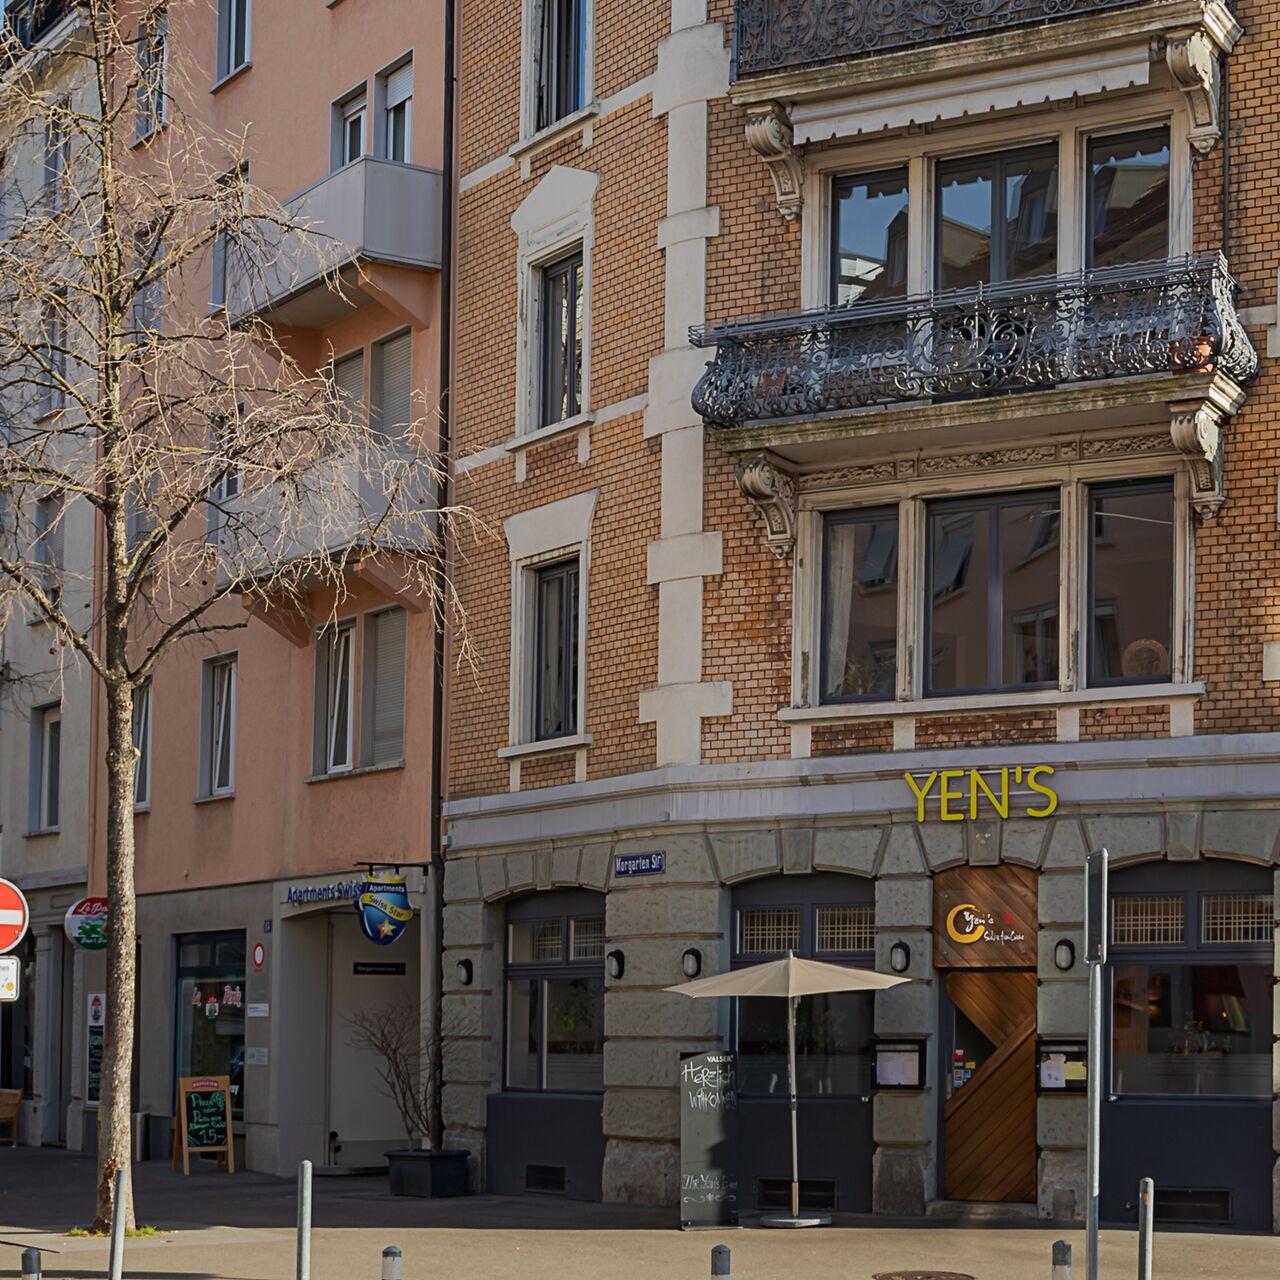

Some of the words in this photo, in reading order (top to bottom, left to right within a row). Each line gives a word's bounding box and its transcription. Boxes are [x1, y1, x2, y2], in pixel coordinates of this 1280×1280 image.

[904, 765, 1059, 823] YEN'S
[615, 857, 650, 874] Morgarten
[287, 884, 335, 908] Apartments
[369, 884, 405, 893] Apartments
[368, 895, 389, 911] Swiss
